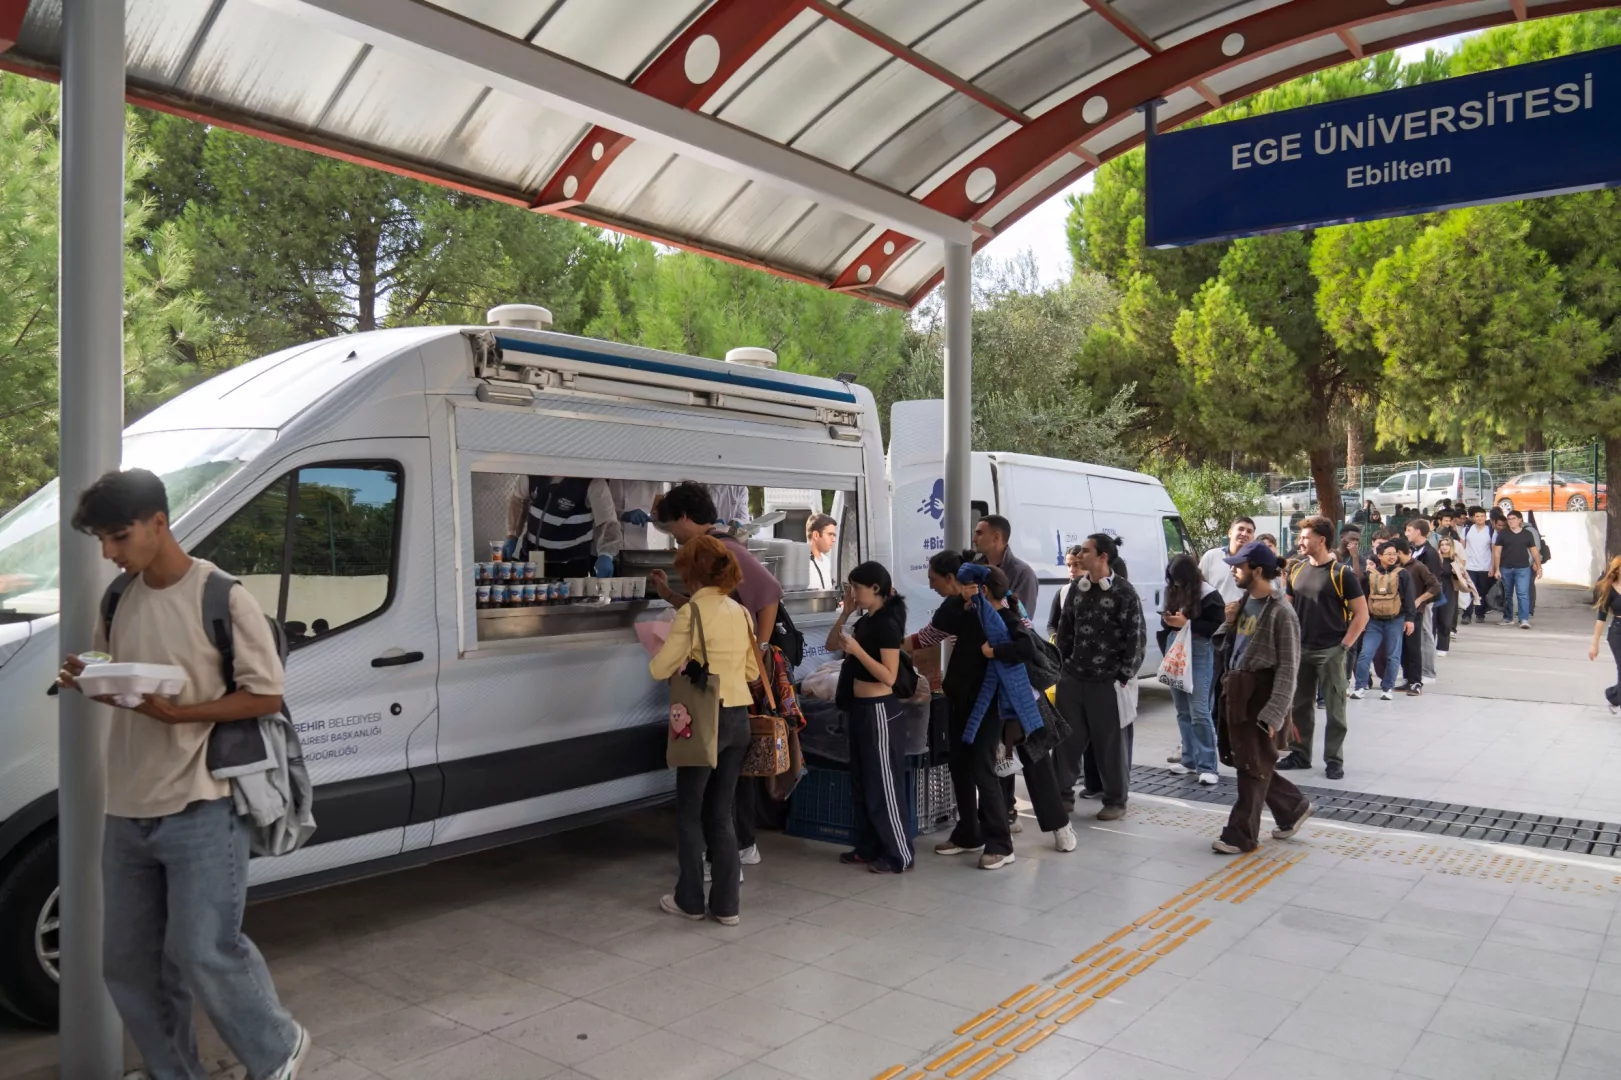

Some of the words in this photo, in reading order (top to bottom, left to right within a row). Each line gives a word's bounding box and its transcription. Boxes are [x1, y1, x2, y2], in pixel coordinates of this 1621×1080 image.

[1231, 133, 1302, 170] EGE
[1314, 72, 1594, 155] ÜNİVERSİTESİ
[1346, 156, 1452, 188] Ebiltem
[923, 536, 944, 550] #Biz
[328, 712, 382, 729] BELEDİYESİ
[300, 733, 328, 746] AİRESİ
